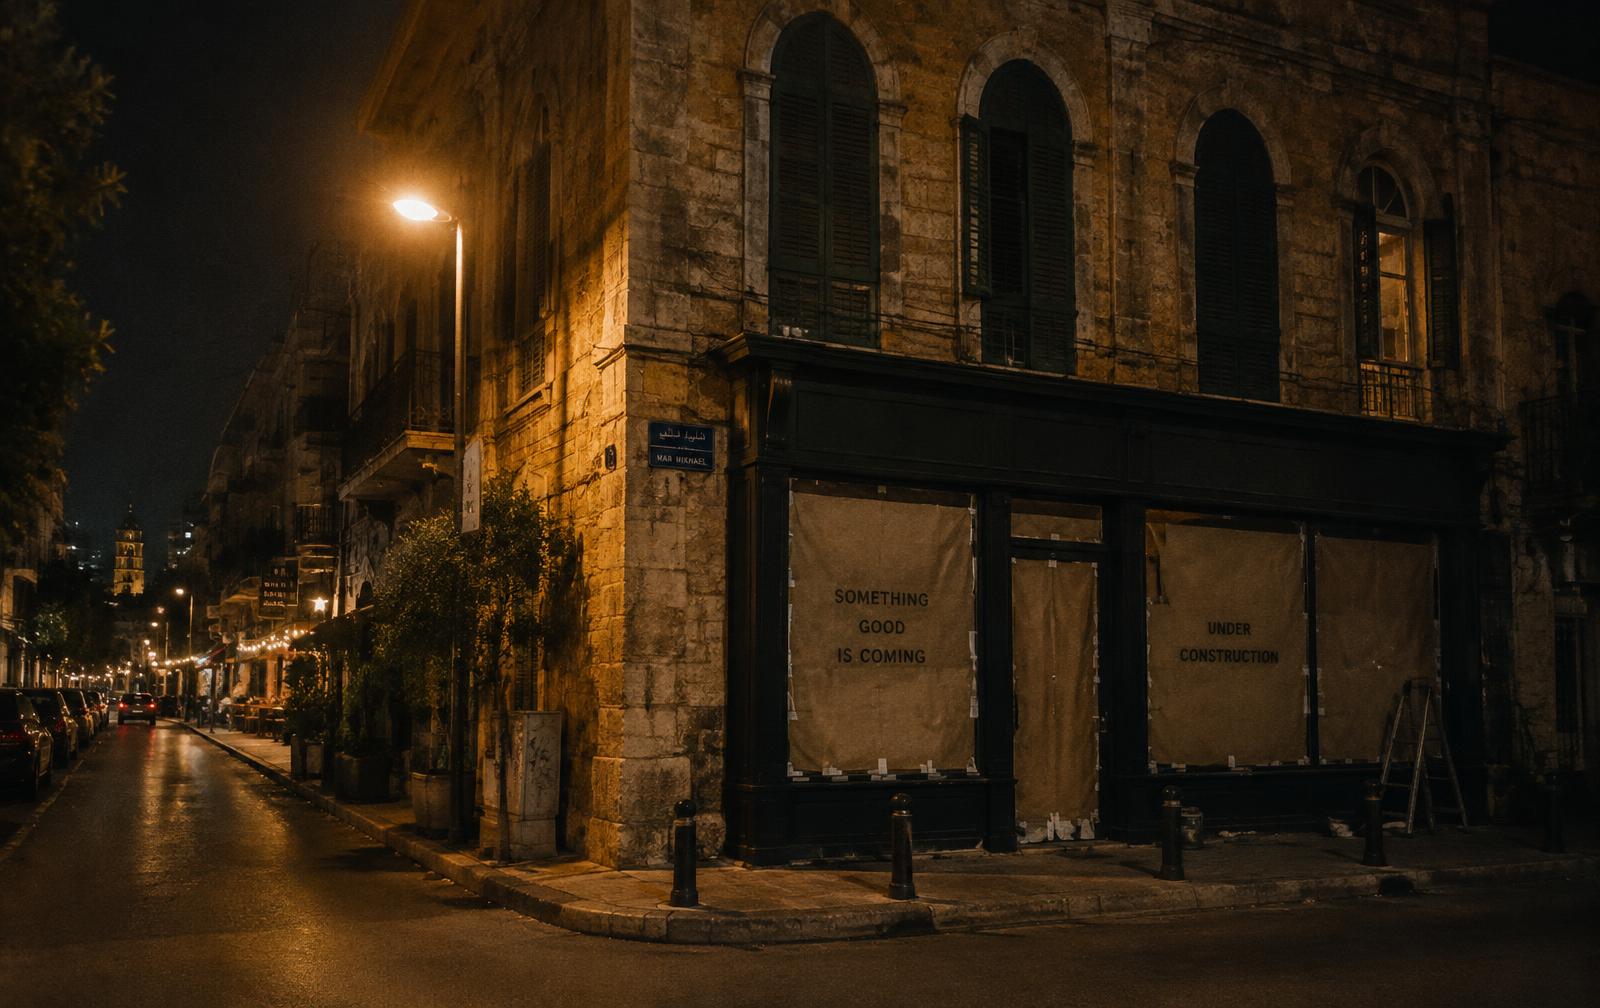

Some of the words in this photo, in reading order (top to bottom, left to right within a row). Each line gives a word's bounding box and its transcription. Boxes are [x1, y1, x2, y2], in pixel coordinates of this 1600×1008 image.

[656, 453, 672, 462] MAR
[835, 589, 928, 607] SOMETHING
[859, 619, 905, 634] GOOD
[1208, 622, 1251, 635] UNDER
[838, 648, 852, 663] IS
[860, 648, 926, 664] COMING
[1180, 648, 1279, 664] CONSTRUCTION
